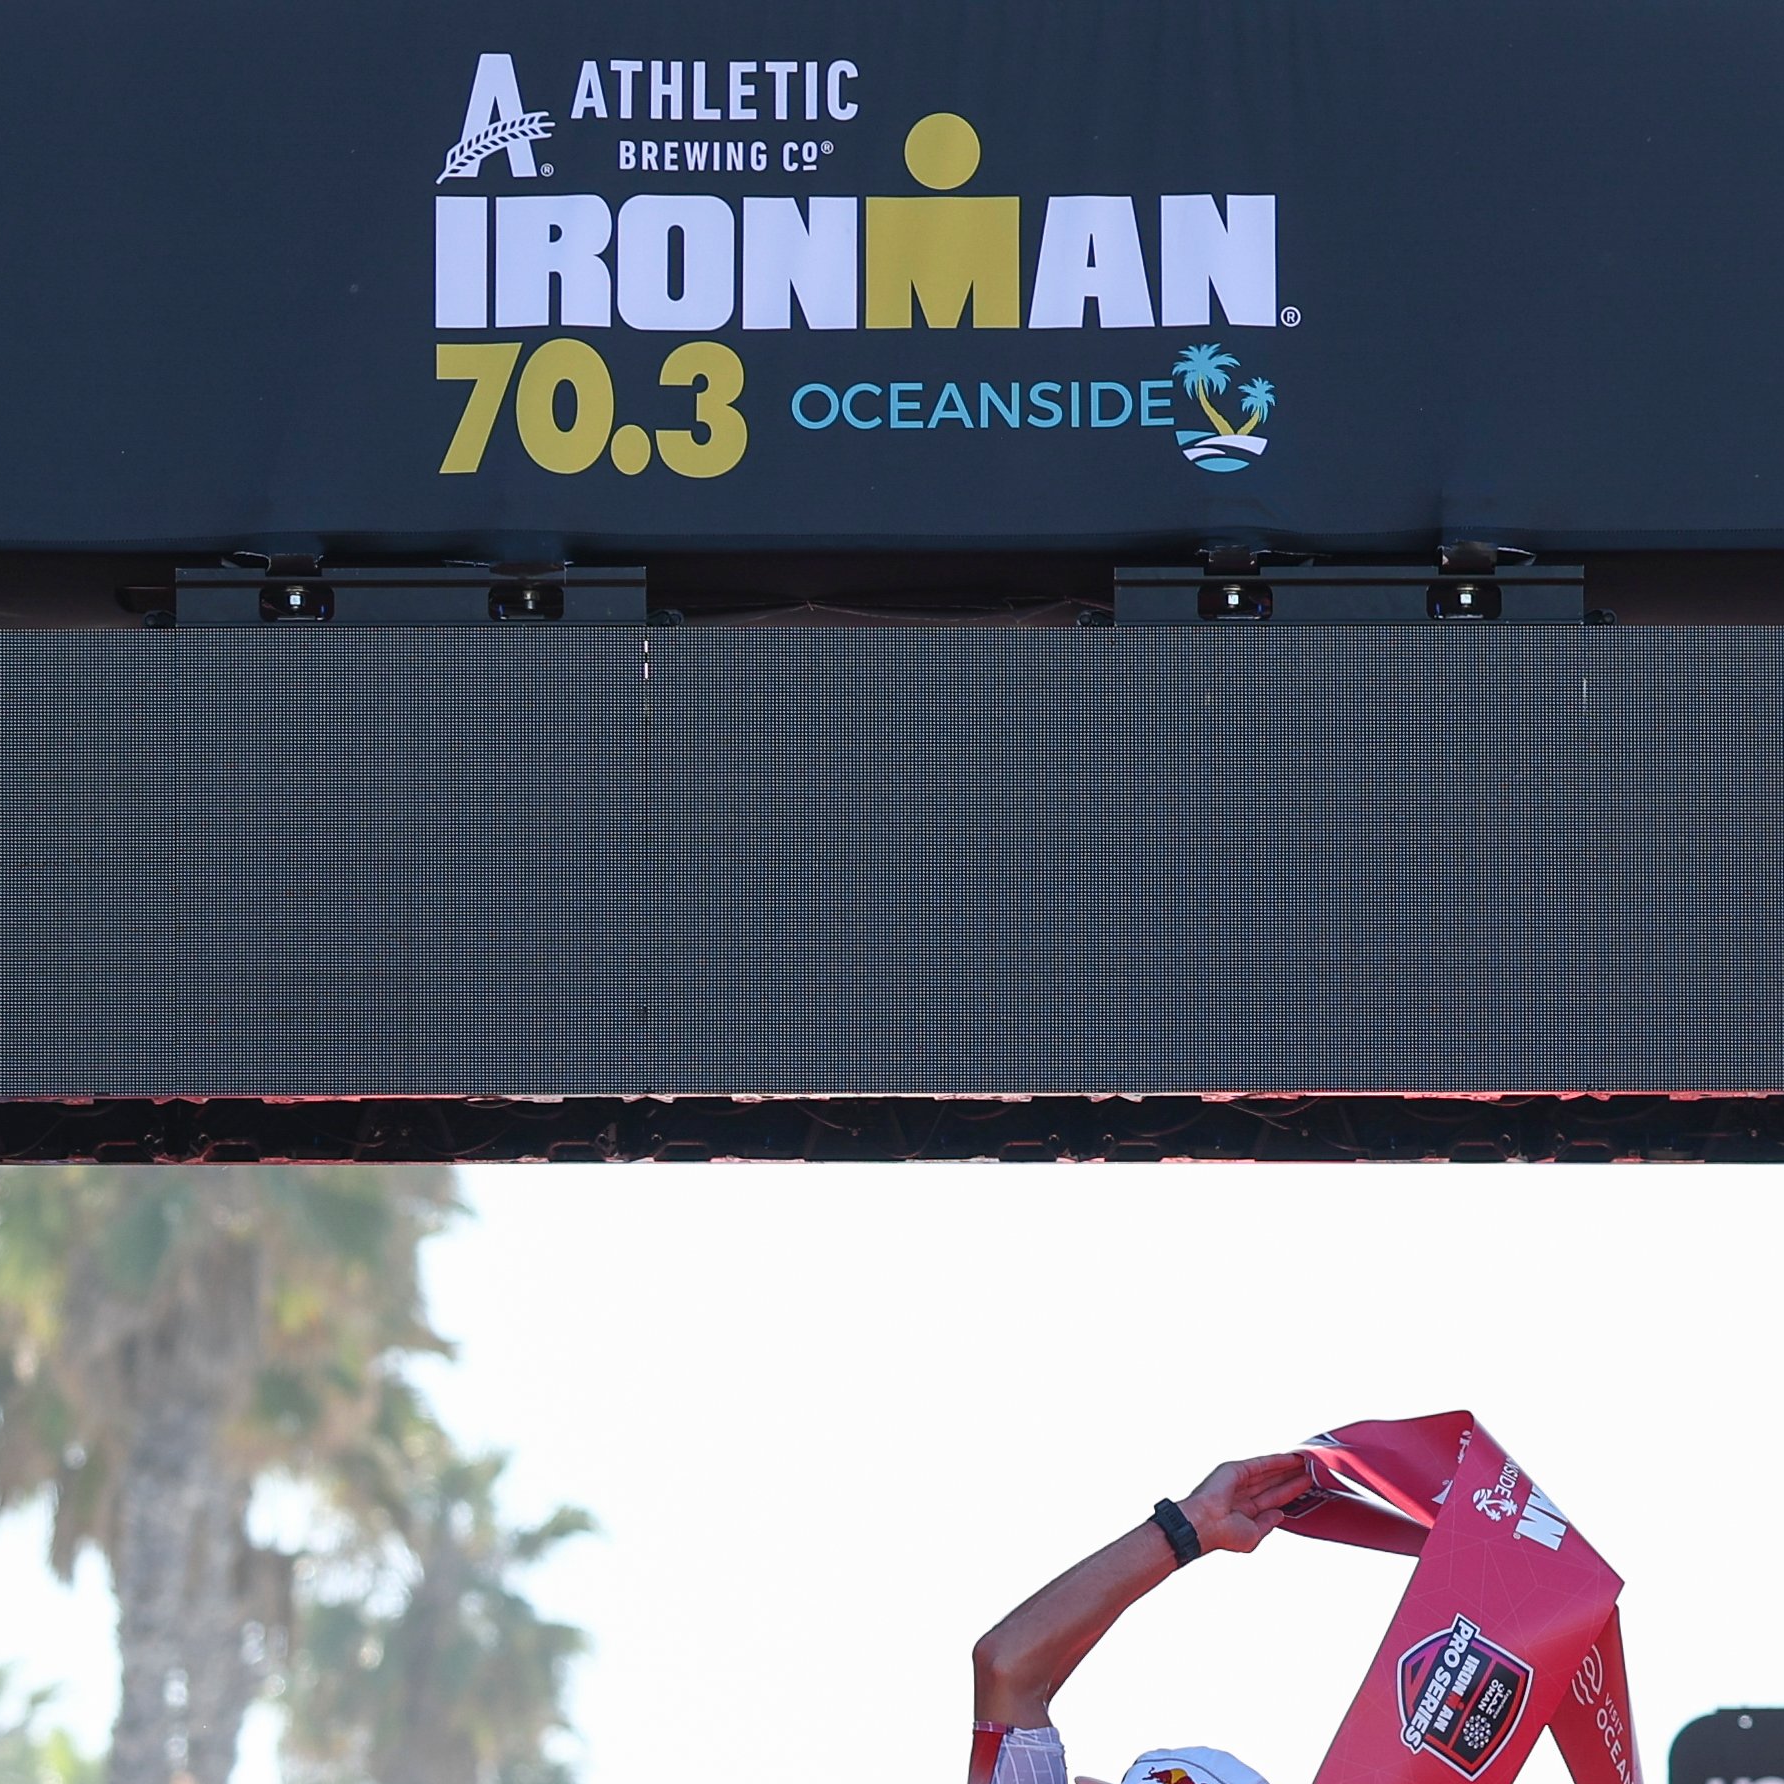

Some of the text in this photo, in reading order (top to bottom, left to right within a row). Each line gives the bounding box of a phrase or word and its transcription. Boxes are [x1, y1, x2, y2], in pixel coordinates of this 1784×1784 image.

[571, 59, 859, 122] ATHLETIC
[618, 140, 767, 173] BREWING
[435, 194, 1276, 330] IRONMAN
[436, 338, 1174, 478] 70.3 OCEANSIDE
[1405, 1620, 1474, 1747] PRO SERIES
[1433, 1654, 1480, 1733] IRONMAN
[1478, 1679, 1499, 1712] OMAN
[1605, 1694, 1623, 1735] VISIT
